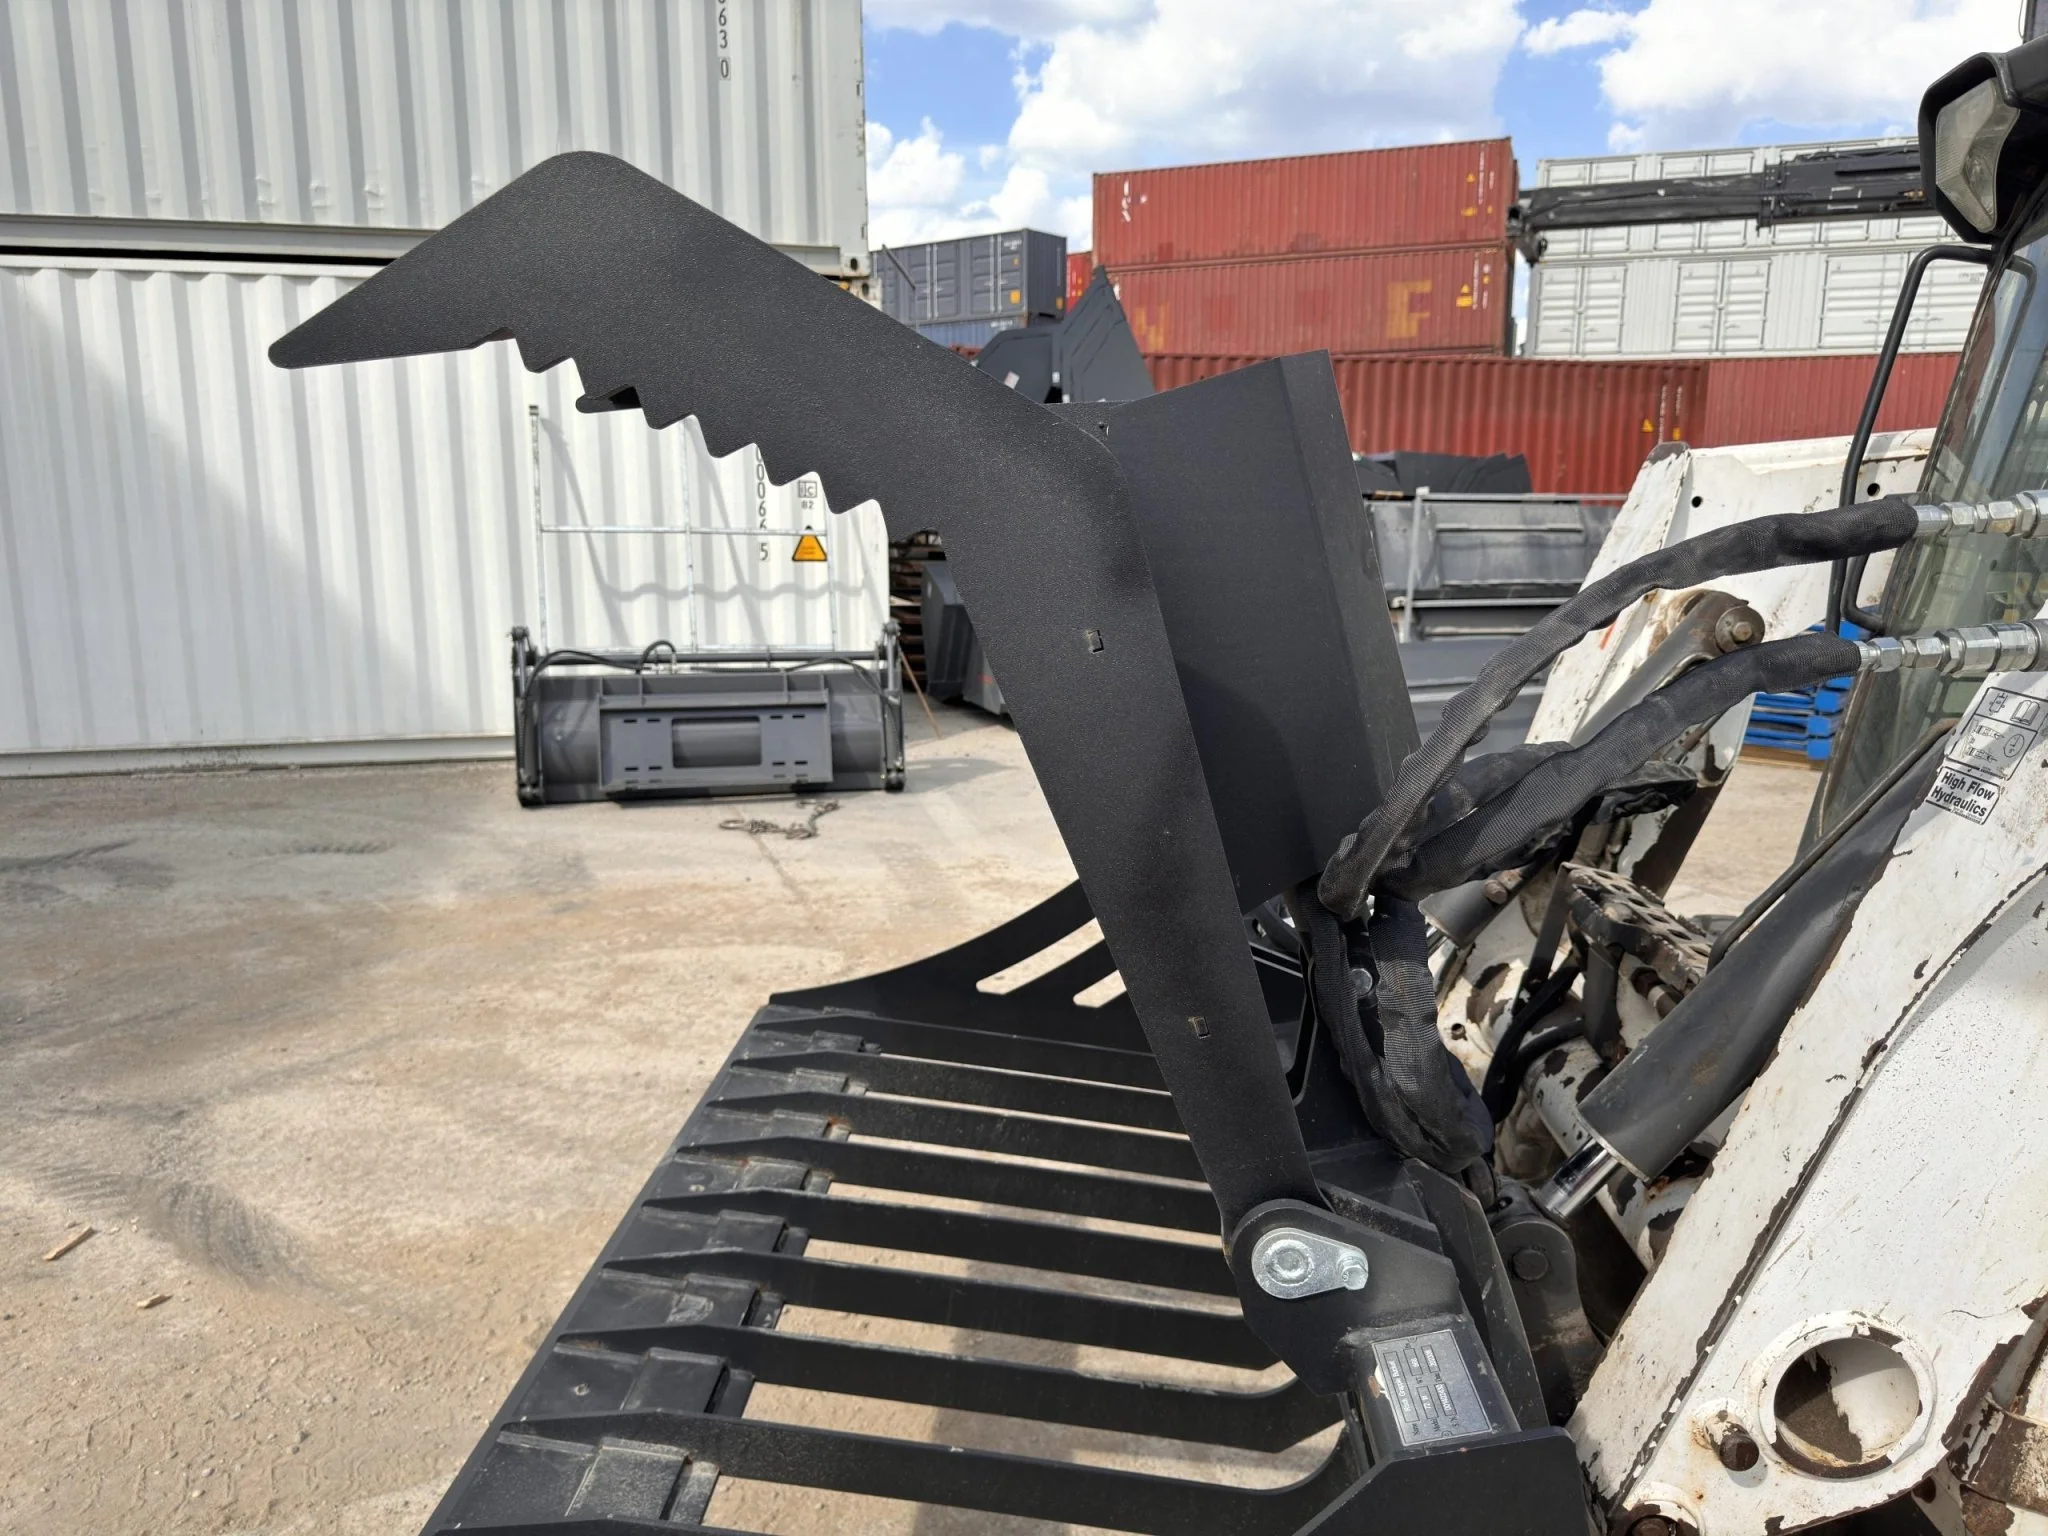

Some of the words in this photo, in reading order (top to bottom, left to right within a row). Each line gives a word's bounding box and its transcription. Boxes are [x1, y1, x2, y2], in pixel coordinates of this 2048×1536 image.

[718, 0, 728, 50] 63
[1931, 786, 1987, 817] Hydraulics
[1941, 772, 1966, 790] High
[1966, 781, 1996, 801] Flow
